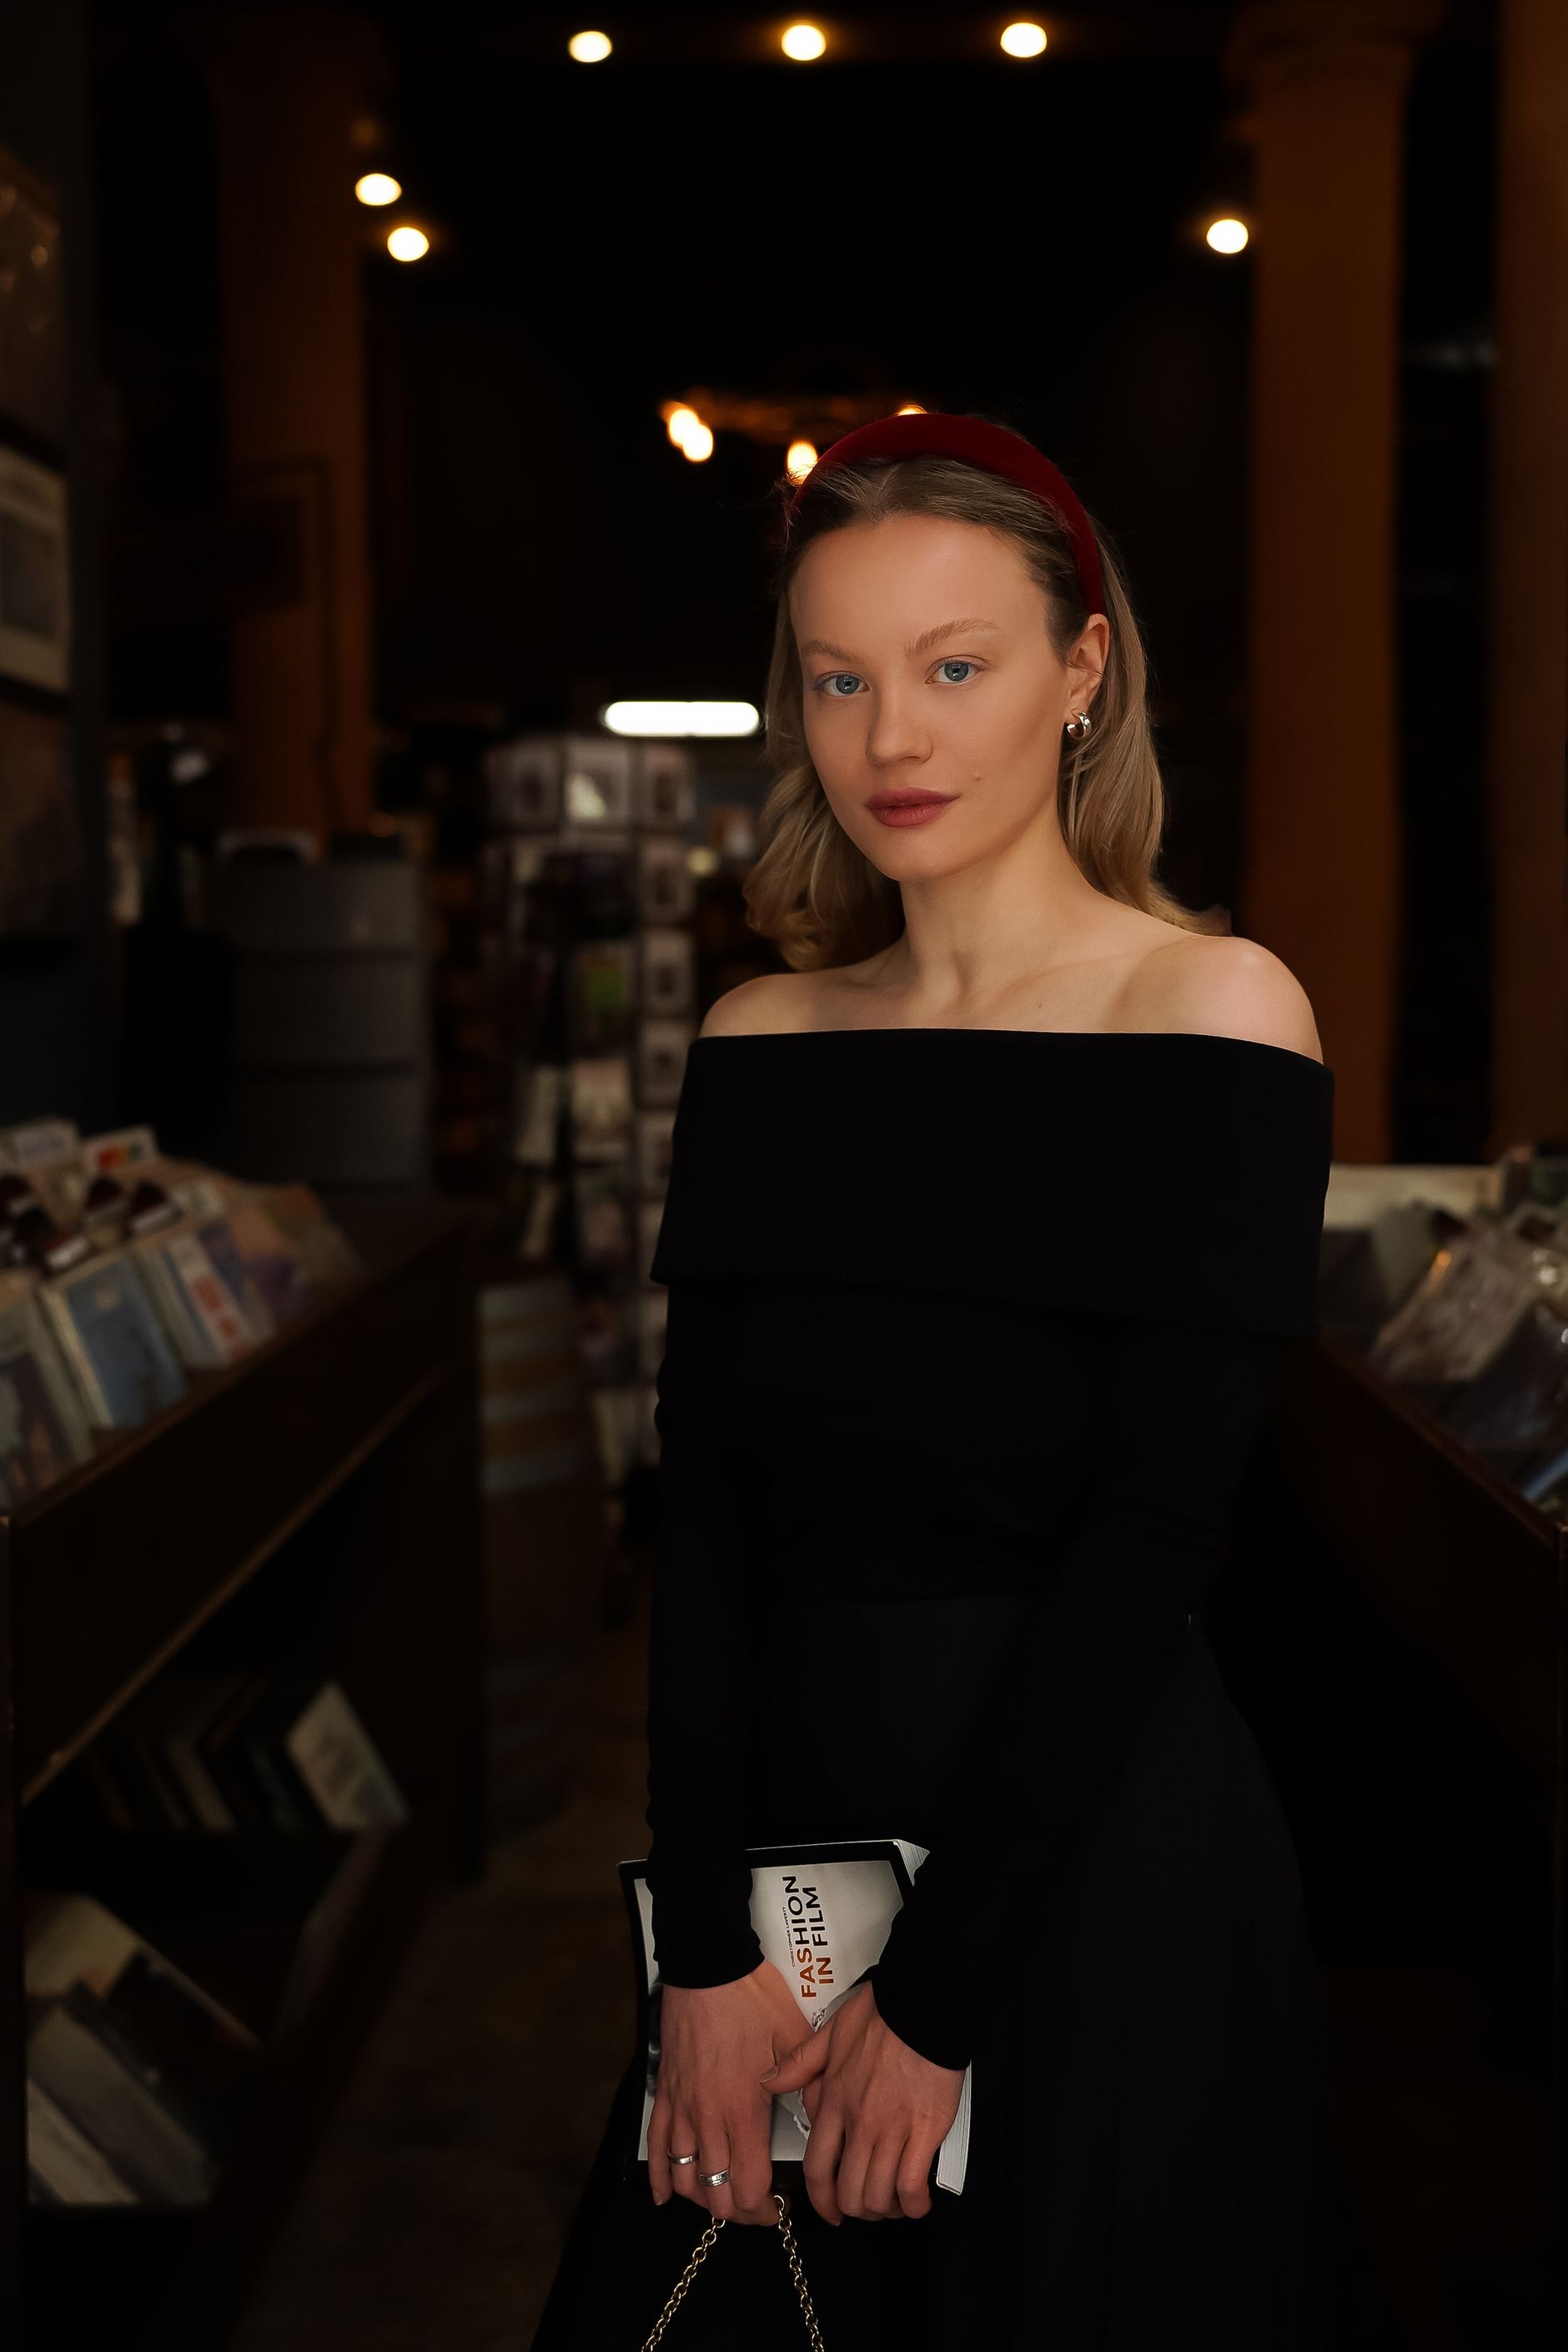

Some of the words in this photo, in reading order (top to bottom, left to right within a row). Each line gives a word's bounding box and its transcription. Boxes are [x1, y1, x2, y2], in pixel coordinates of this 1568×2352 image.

[782, 1876, 817, 1998] FASHION
[802, 1887, 828, 1947] FILM
[817, 1957, 834, 1984] IN
